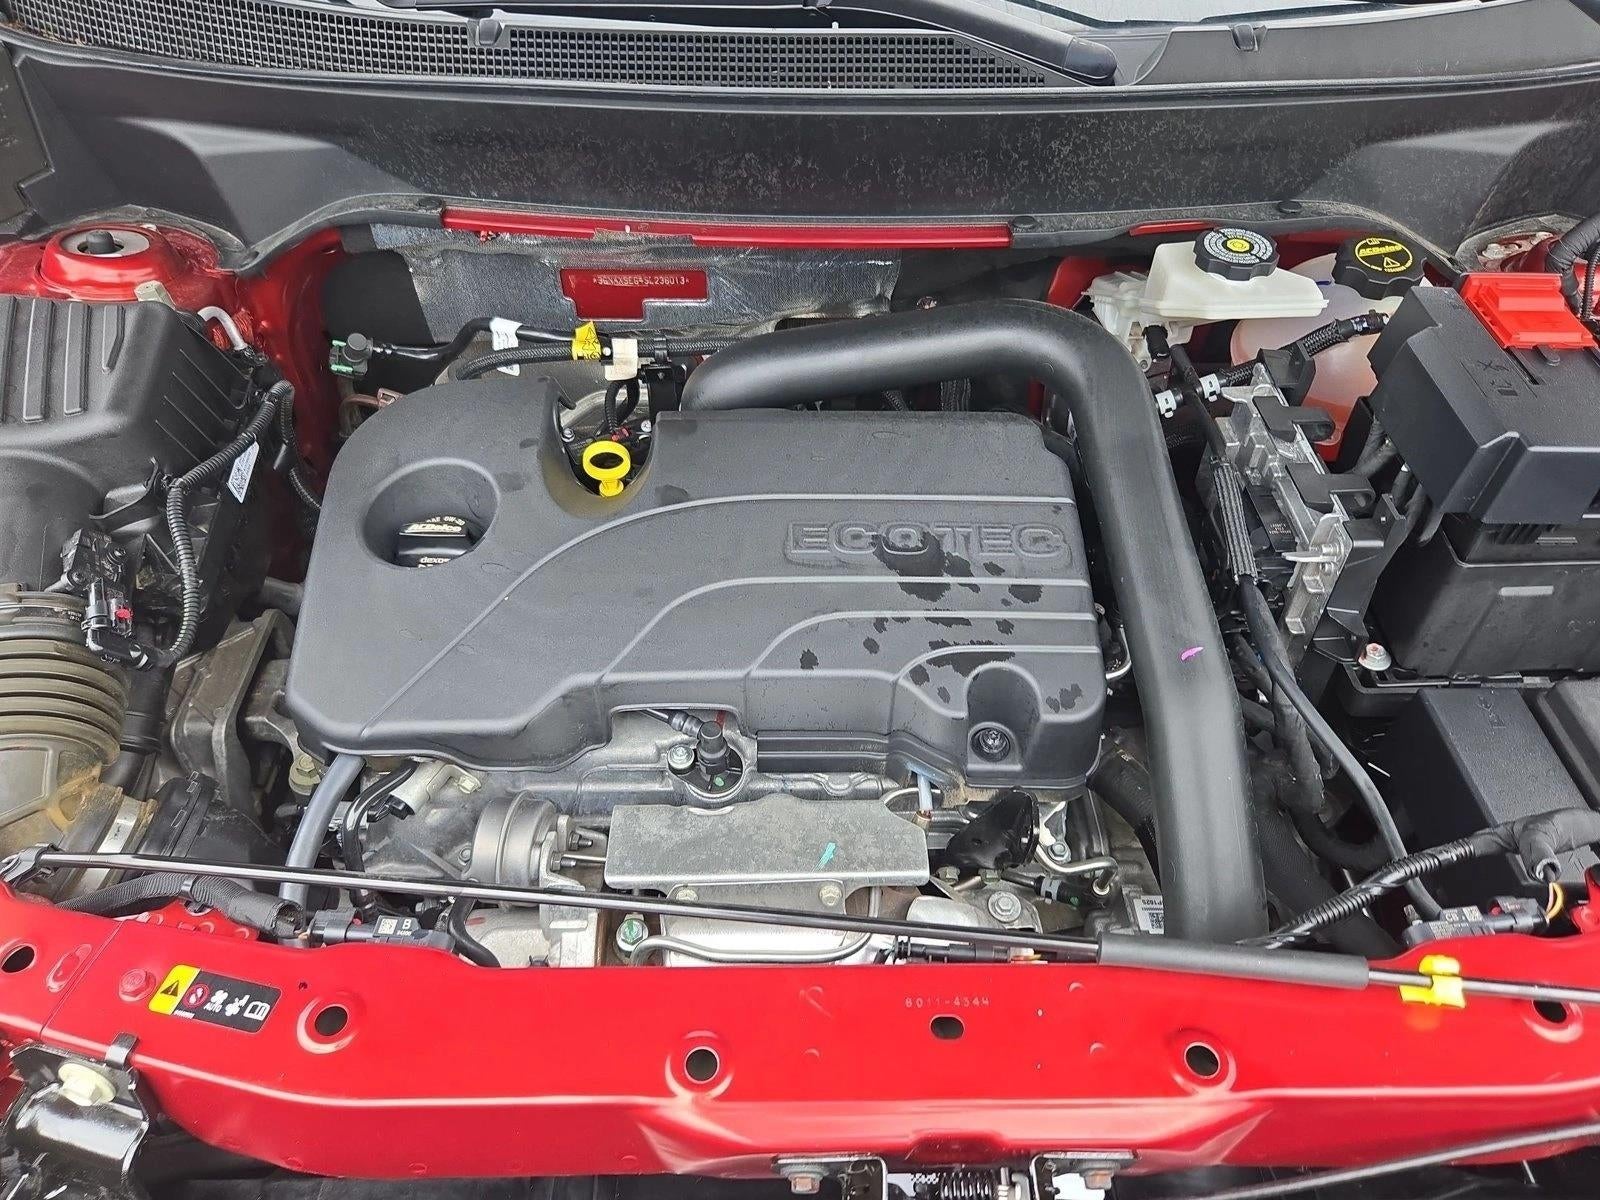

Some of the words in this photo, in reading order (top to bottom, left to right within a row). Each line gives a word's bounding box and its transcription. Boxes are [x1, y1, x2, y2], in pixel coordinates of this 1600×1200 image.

[404, 523, 462, 533] ACDelco
[787, 522, 1068, 558] ECOTEC
[402, 918, 412, 930] B
[204, 1002, 222, 1013] AUTO
